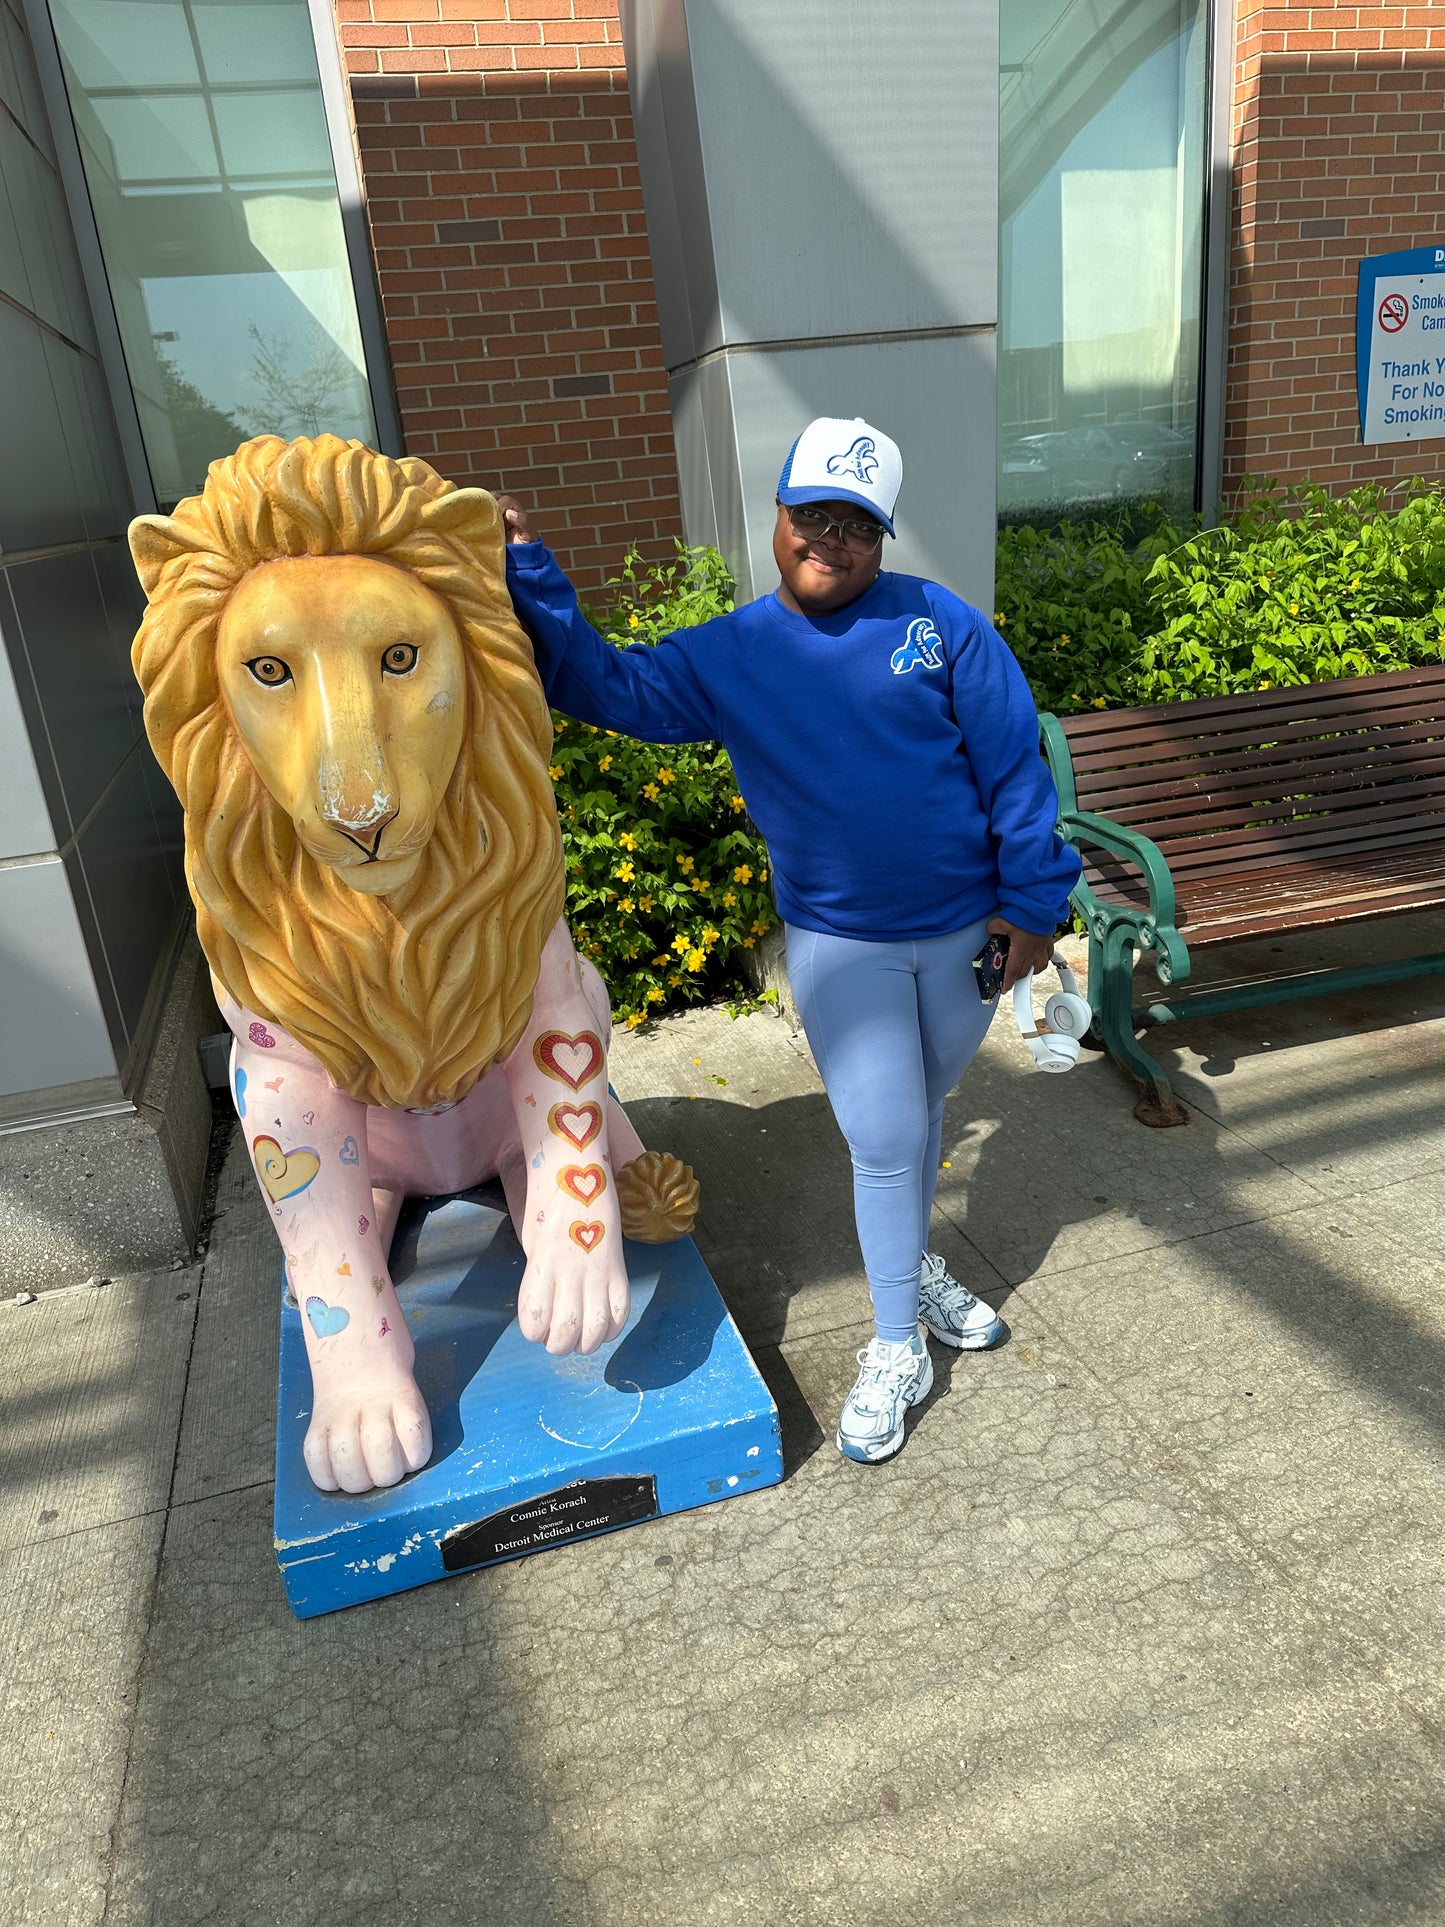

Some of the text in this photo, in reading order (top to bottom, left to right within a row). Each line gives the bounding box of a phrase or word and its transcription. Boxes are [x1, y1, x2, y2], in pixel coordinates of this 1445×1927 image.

[1412, 293, 1445, 310] Smok
[1381, 359, 1430, 378] Thank
[1392, 384, 1419, 401] For
[1384, 404, 1445, 424] Smokin
[510, 1496, 587, 1523] Connie Korach
[494, 1515, 610, 1552] Detroit Medical Center
[538, 1518, 565, 1531] Sponsor
